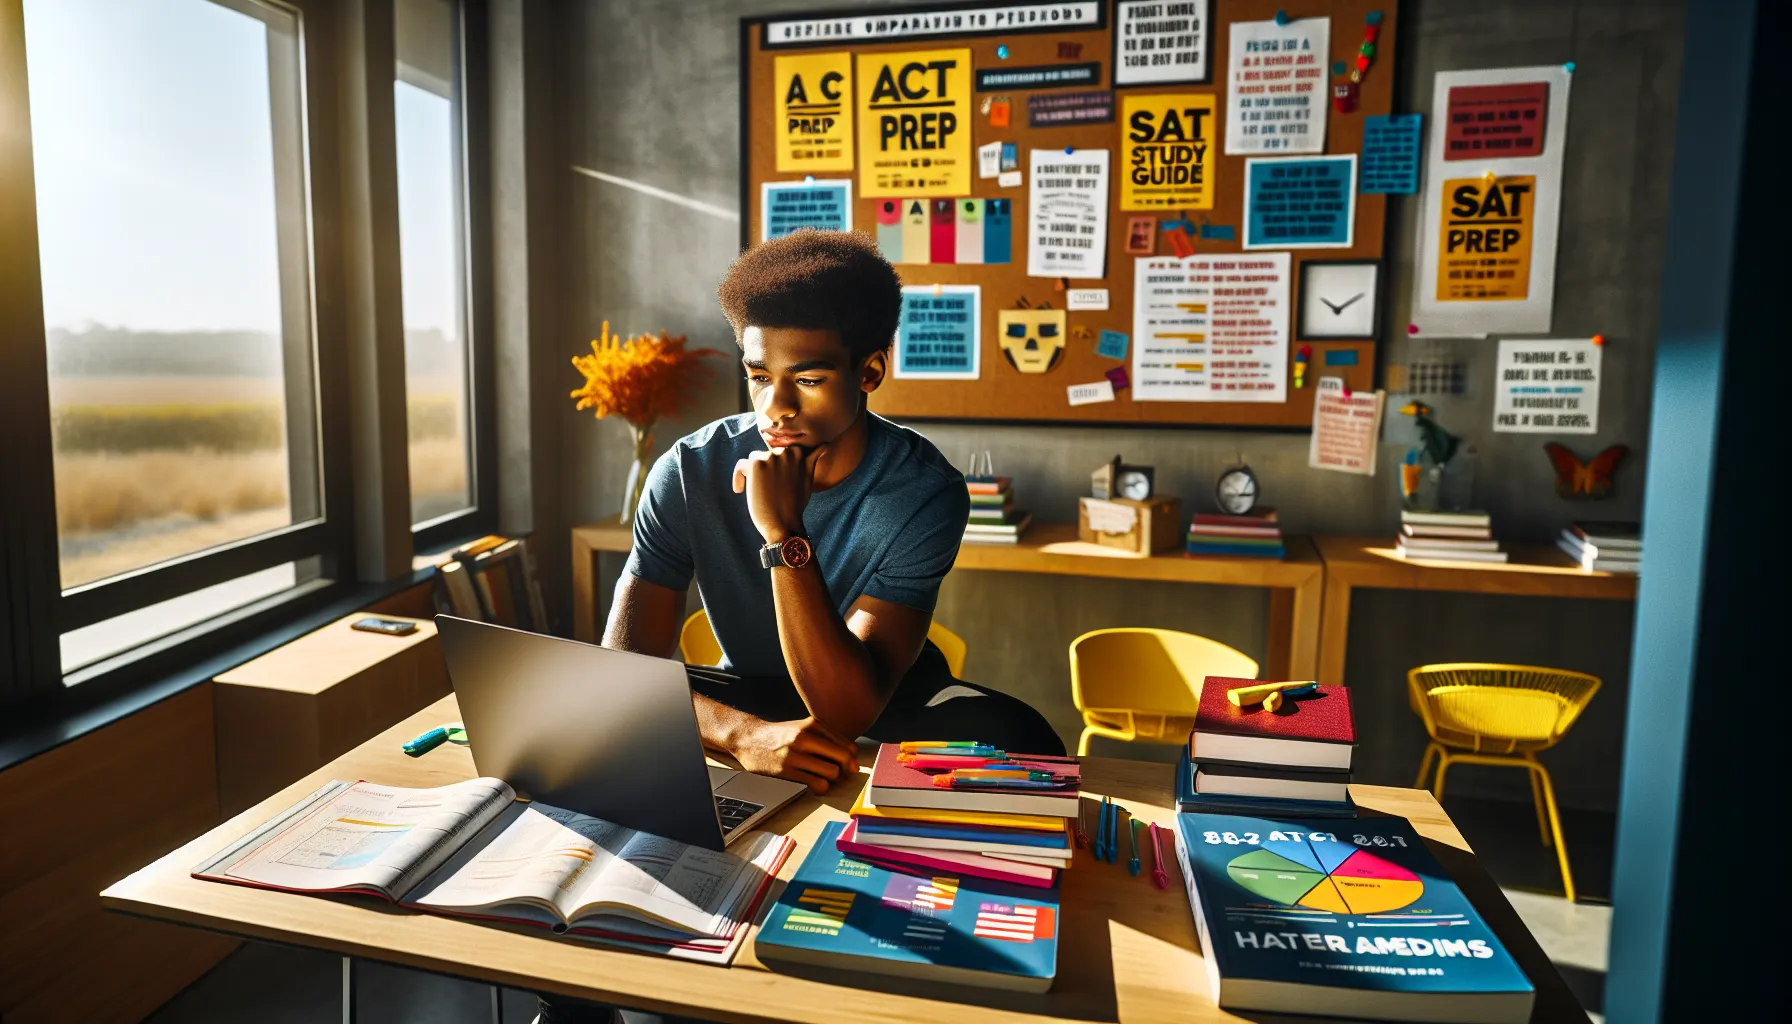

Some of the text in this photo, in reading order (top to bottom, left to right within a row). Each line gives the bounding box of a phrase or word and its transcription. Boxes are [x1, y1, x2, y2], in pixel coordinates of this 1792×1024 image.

[869, 60, 957, 103] ACT
[788, 117, 836, 134] PREP
[880, 112, 957, 151] PREP
[1129, 107, 1212, 143] SAT
[1131, 144, 1207, 166] STUDY
[1131, 163, 1204, 186] GUIDE
[1451, 184, 1531, 218] SAT
[1447, 229, 1521, 254] PREP
[1234, 930, 1353, 954] HATER
